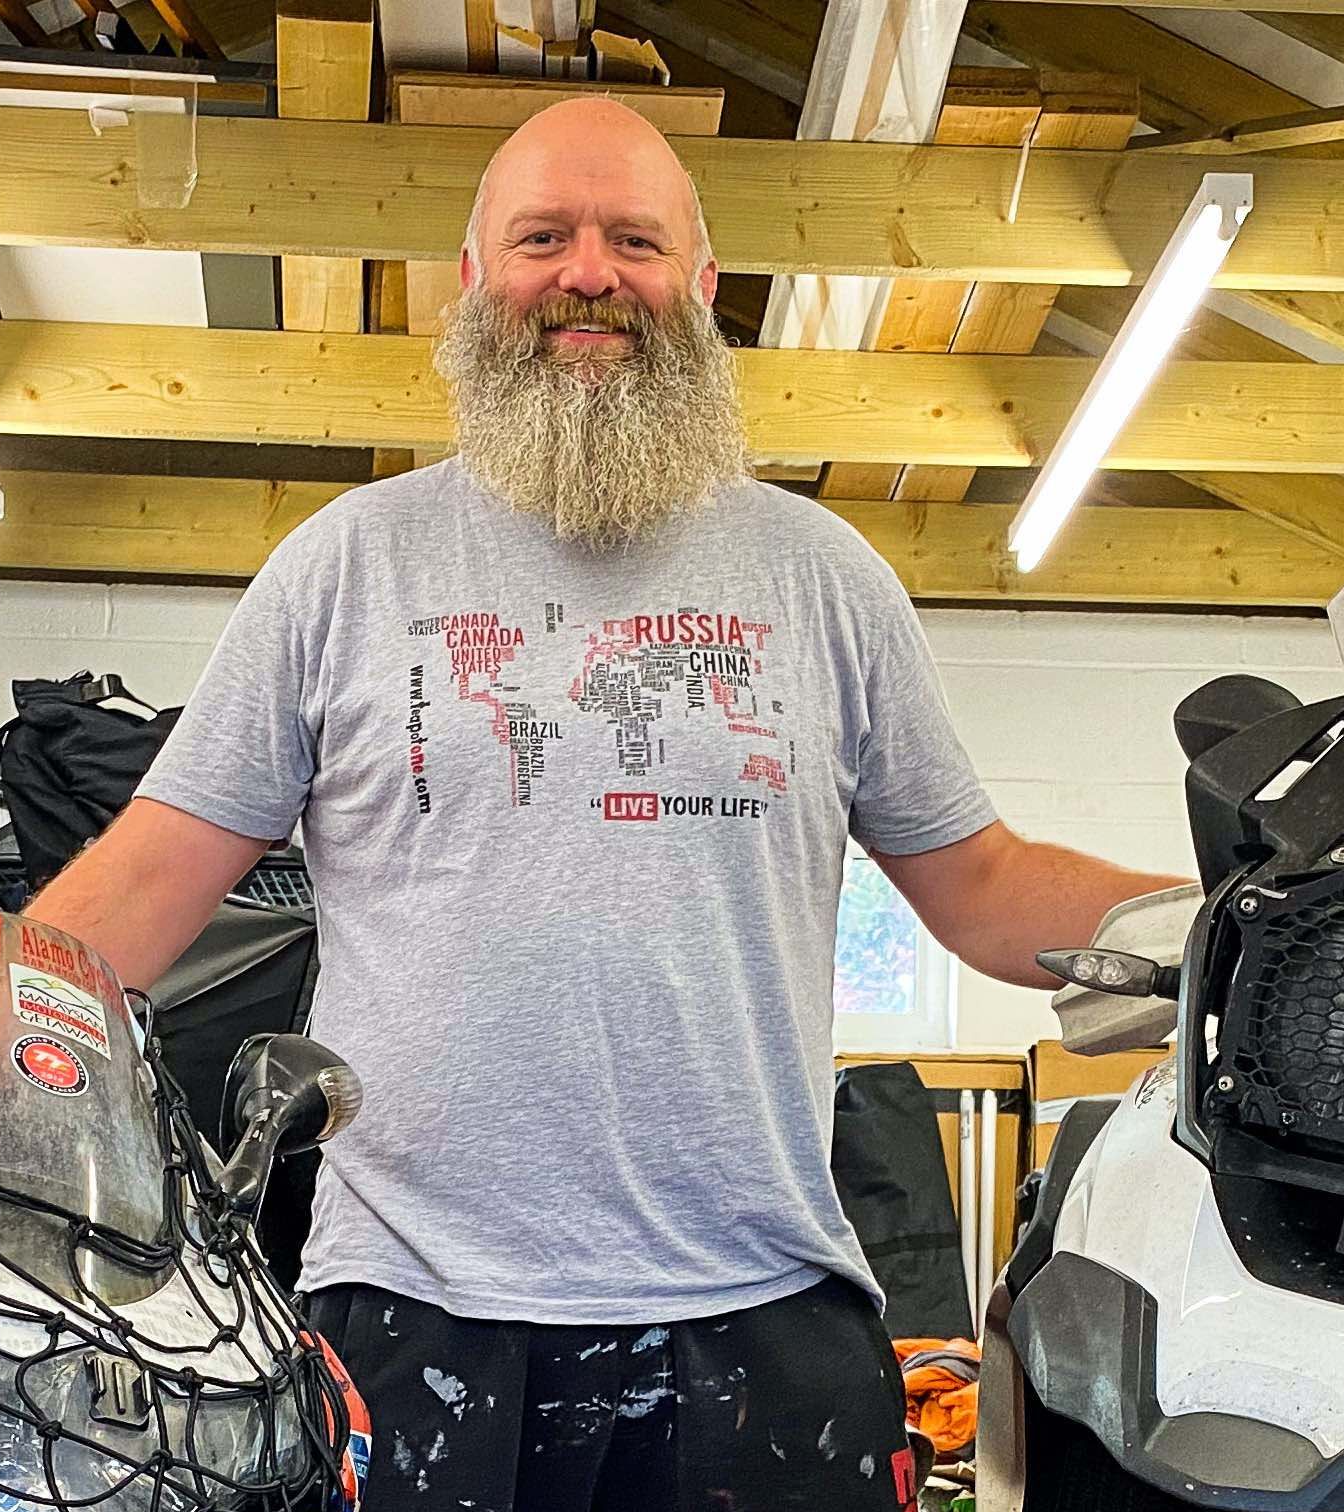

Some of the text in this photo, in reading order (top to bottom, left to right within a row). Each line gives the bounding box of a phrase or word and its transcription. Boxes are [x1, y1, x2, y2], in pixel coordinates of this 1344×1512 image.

[408, 625, 441, 636] STATES
[441, 613, 500, 631] CANADA
[634, 613, 744, 647] RUSSIA
[446, 628, 525, 649] CANADA
[451, 648, 501, 662] UNITED
[689, 652, 750, 676] CHINA
[452, 660, 502, 675] STATES
[686, 674, 706, 709] INDIA
[720, 675, 751, 688] CHINA
[630, 685, 643, 712] SUDAN
[406, 665, 431, 814] www.teapotone.com
[509, 720, 563, 740] BRAZIL
[517, 754, 531, 807] ARGENTINA
[660, 796, 713, 817] YOUR
[22, 925, 74, 972] Alamo
[19, 989, 104, 1033] MALAYSIAN
